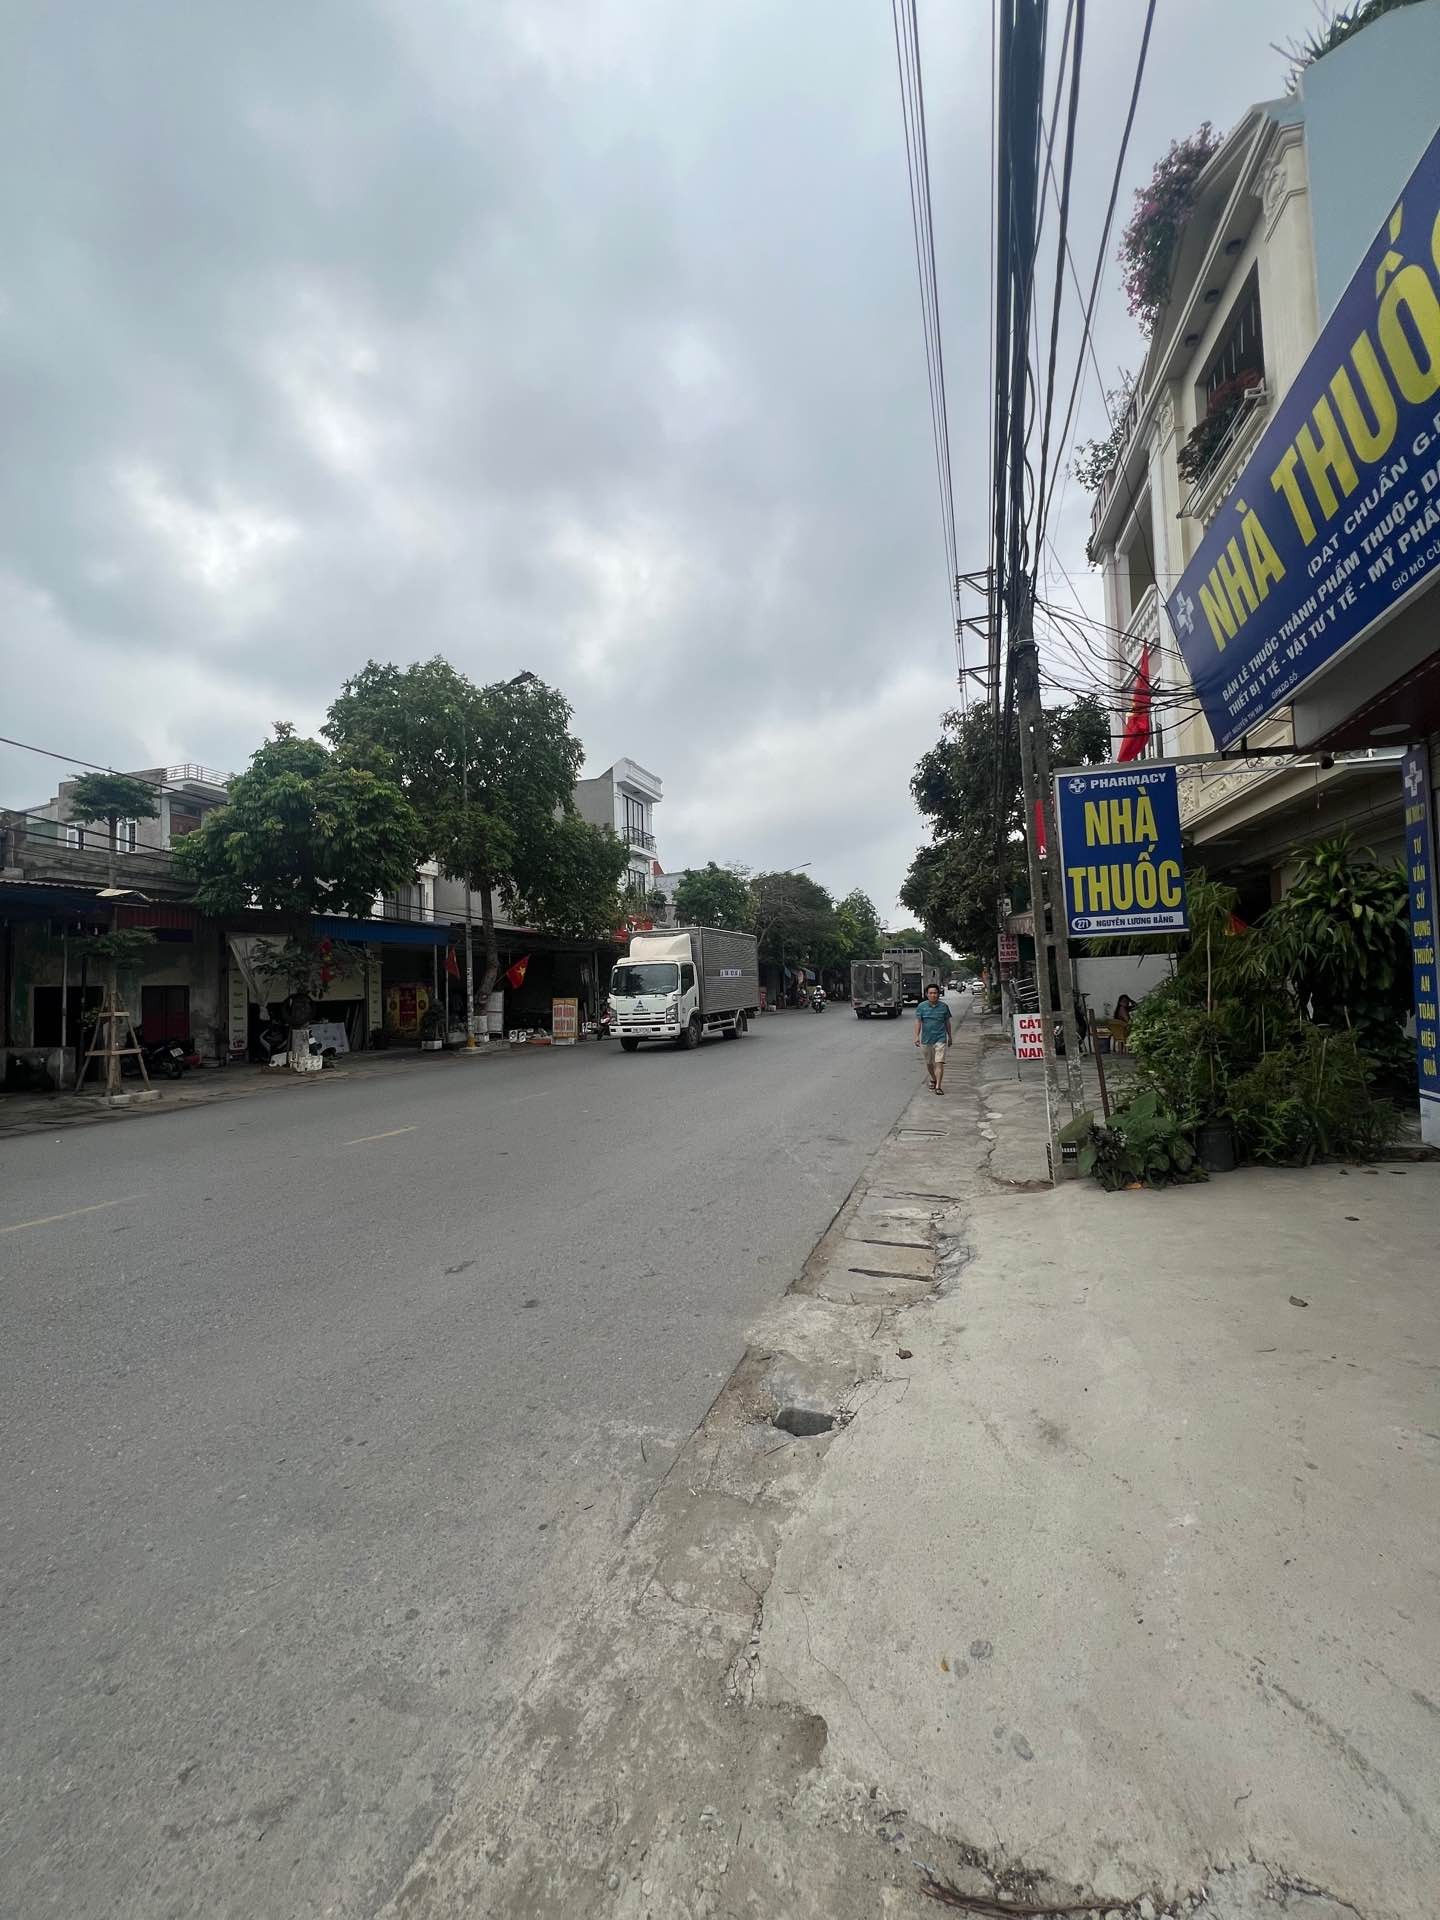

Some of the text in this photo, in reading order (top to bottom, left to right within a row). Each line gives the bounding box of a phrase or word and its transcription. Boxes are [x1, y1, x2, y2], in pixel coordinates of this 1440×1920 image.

[1198, 201, 1440, 652] NHÀ THUỐ
[1307, 533, 1340, 578] (ĐẠT
[1344, 456, 1409, 535] CHUẨN
[1391, 570, 1409, 592] GIỜ
[1222, 676, 1239, 701] BÁN
[1238, 663, 1250, 685] LẺ
[1248, 637, 1279, 673] THUỐC
[1278, 596, 1318, 641] THÀNH
[1317, 552, 1361, 602] PHẨM
[1360, 489, 1419, 555] THUỘC
[1228, 690, 1250, 717] THIẾT
[1249, 680, 1261, 697] BỊ
[1259, 673, 1268, 687] Y
[1266, 657, 1280, 680] TẾ
[1286, 632, 1310, 661] VẬT
[1308, 613, 1328, 640] TƯ
[1323, 605, 1336, 624] Y
[1337, 580, 1359, 612] TẾ
[1368, 545, 1396, 584] MỸ
[1090, 773, 1166, 789] PHARMACY
[1084, 786, 1158, 847] NHÀ
[1068, 844, 1182, 913] THUỐC
[1412, 860, 1426, 882] VẤN
[1096, 916, 1126, 927] NGUYỄN
[1127, 915, 1151, 926] LƯƠNG
[1413, 942, 1435, 965] THUỐC
[1420, 975, 1430, 992] AN
[1418, 1000, 1436, 1021] TOÀN
[1420, 1028, 1437, 1051] HIỆU
